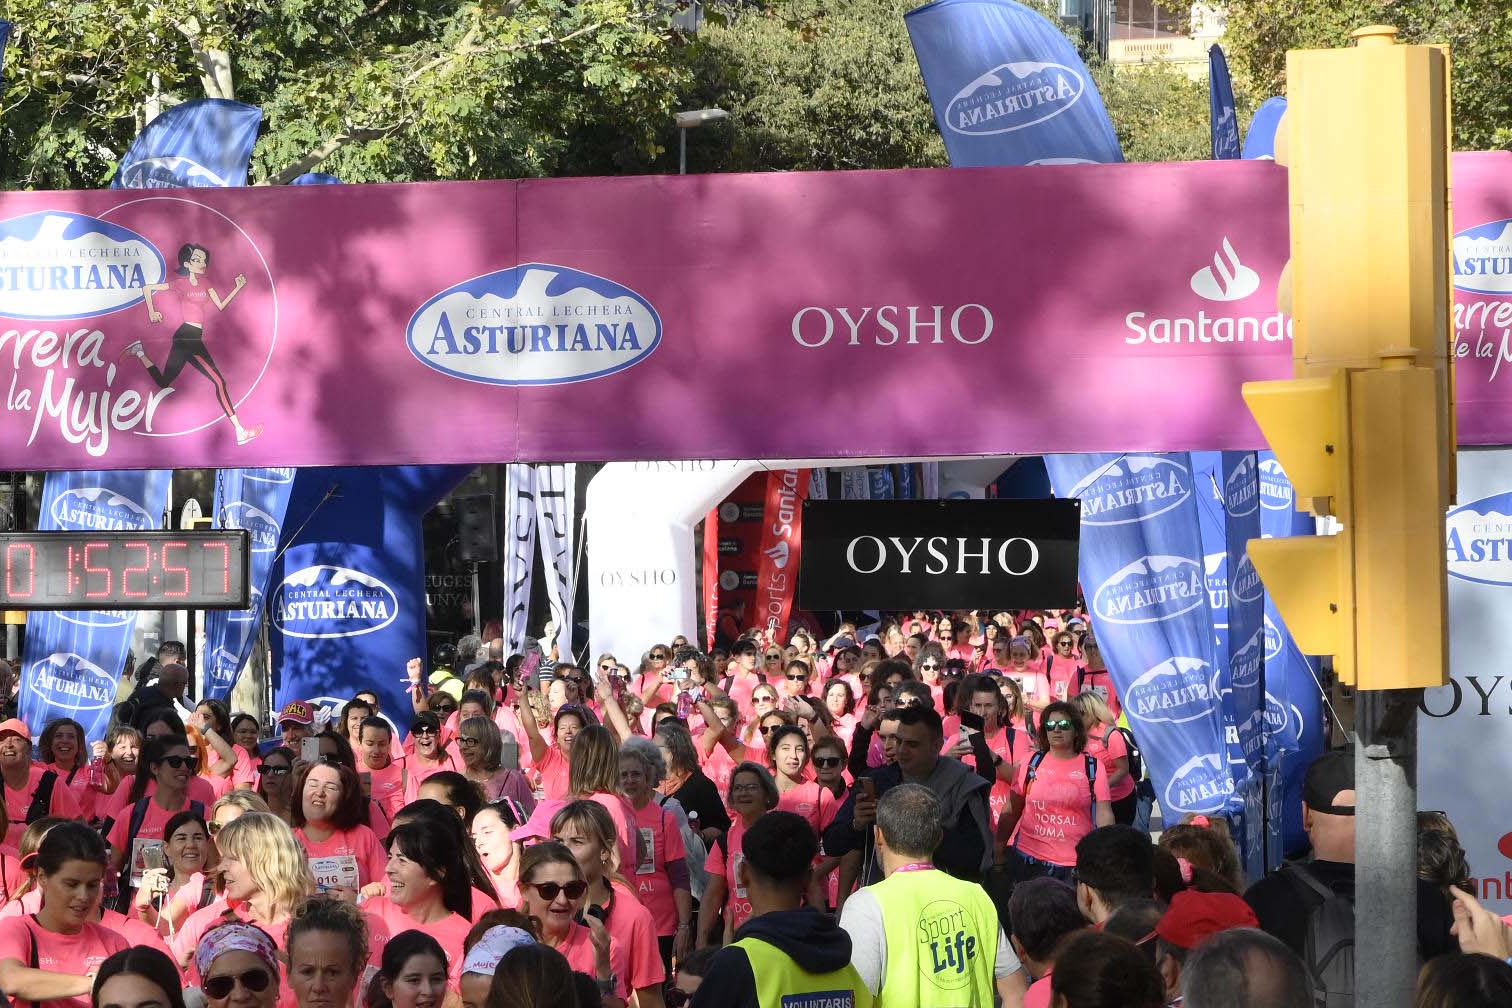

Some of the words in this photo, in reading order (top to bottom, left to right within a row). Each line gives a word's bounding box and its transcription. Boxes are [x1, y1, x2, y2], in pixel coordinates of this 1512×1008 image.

[466, 306, 544, 319] CENTRAL
[552, 304, 633, 316] LECHERA
[791, 303, 994, 347] OYSHO
[426, 312, 642, 354] ASTURIANA
[1475, 331, 1492, 358] la
[8, 370, 31, 411] la
[26, 363, 175, 457] Mujer
[7, 542, 230, 597] 01:52:57
[847, 536, 1038, 576] OYSHO
[601, 568, 676, 586] OYSHO
[276, 595, 388, 621] ASTURIANA
[288, 590, 331, 599] CENTRAL
[336, 589, 384, 598] LECHERA
[1032, 800, 1045, 810] TU
[1034, 825, 1065, 839] SUMA
[920, 908, 966, 943] Sport
[930, 931, 976, 974] Life
